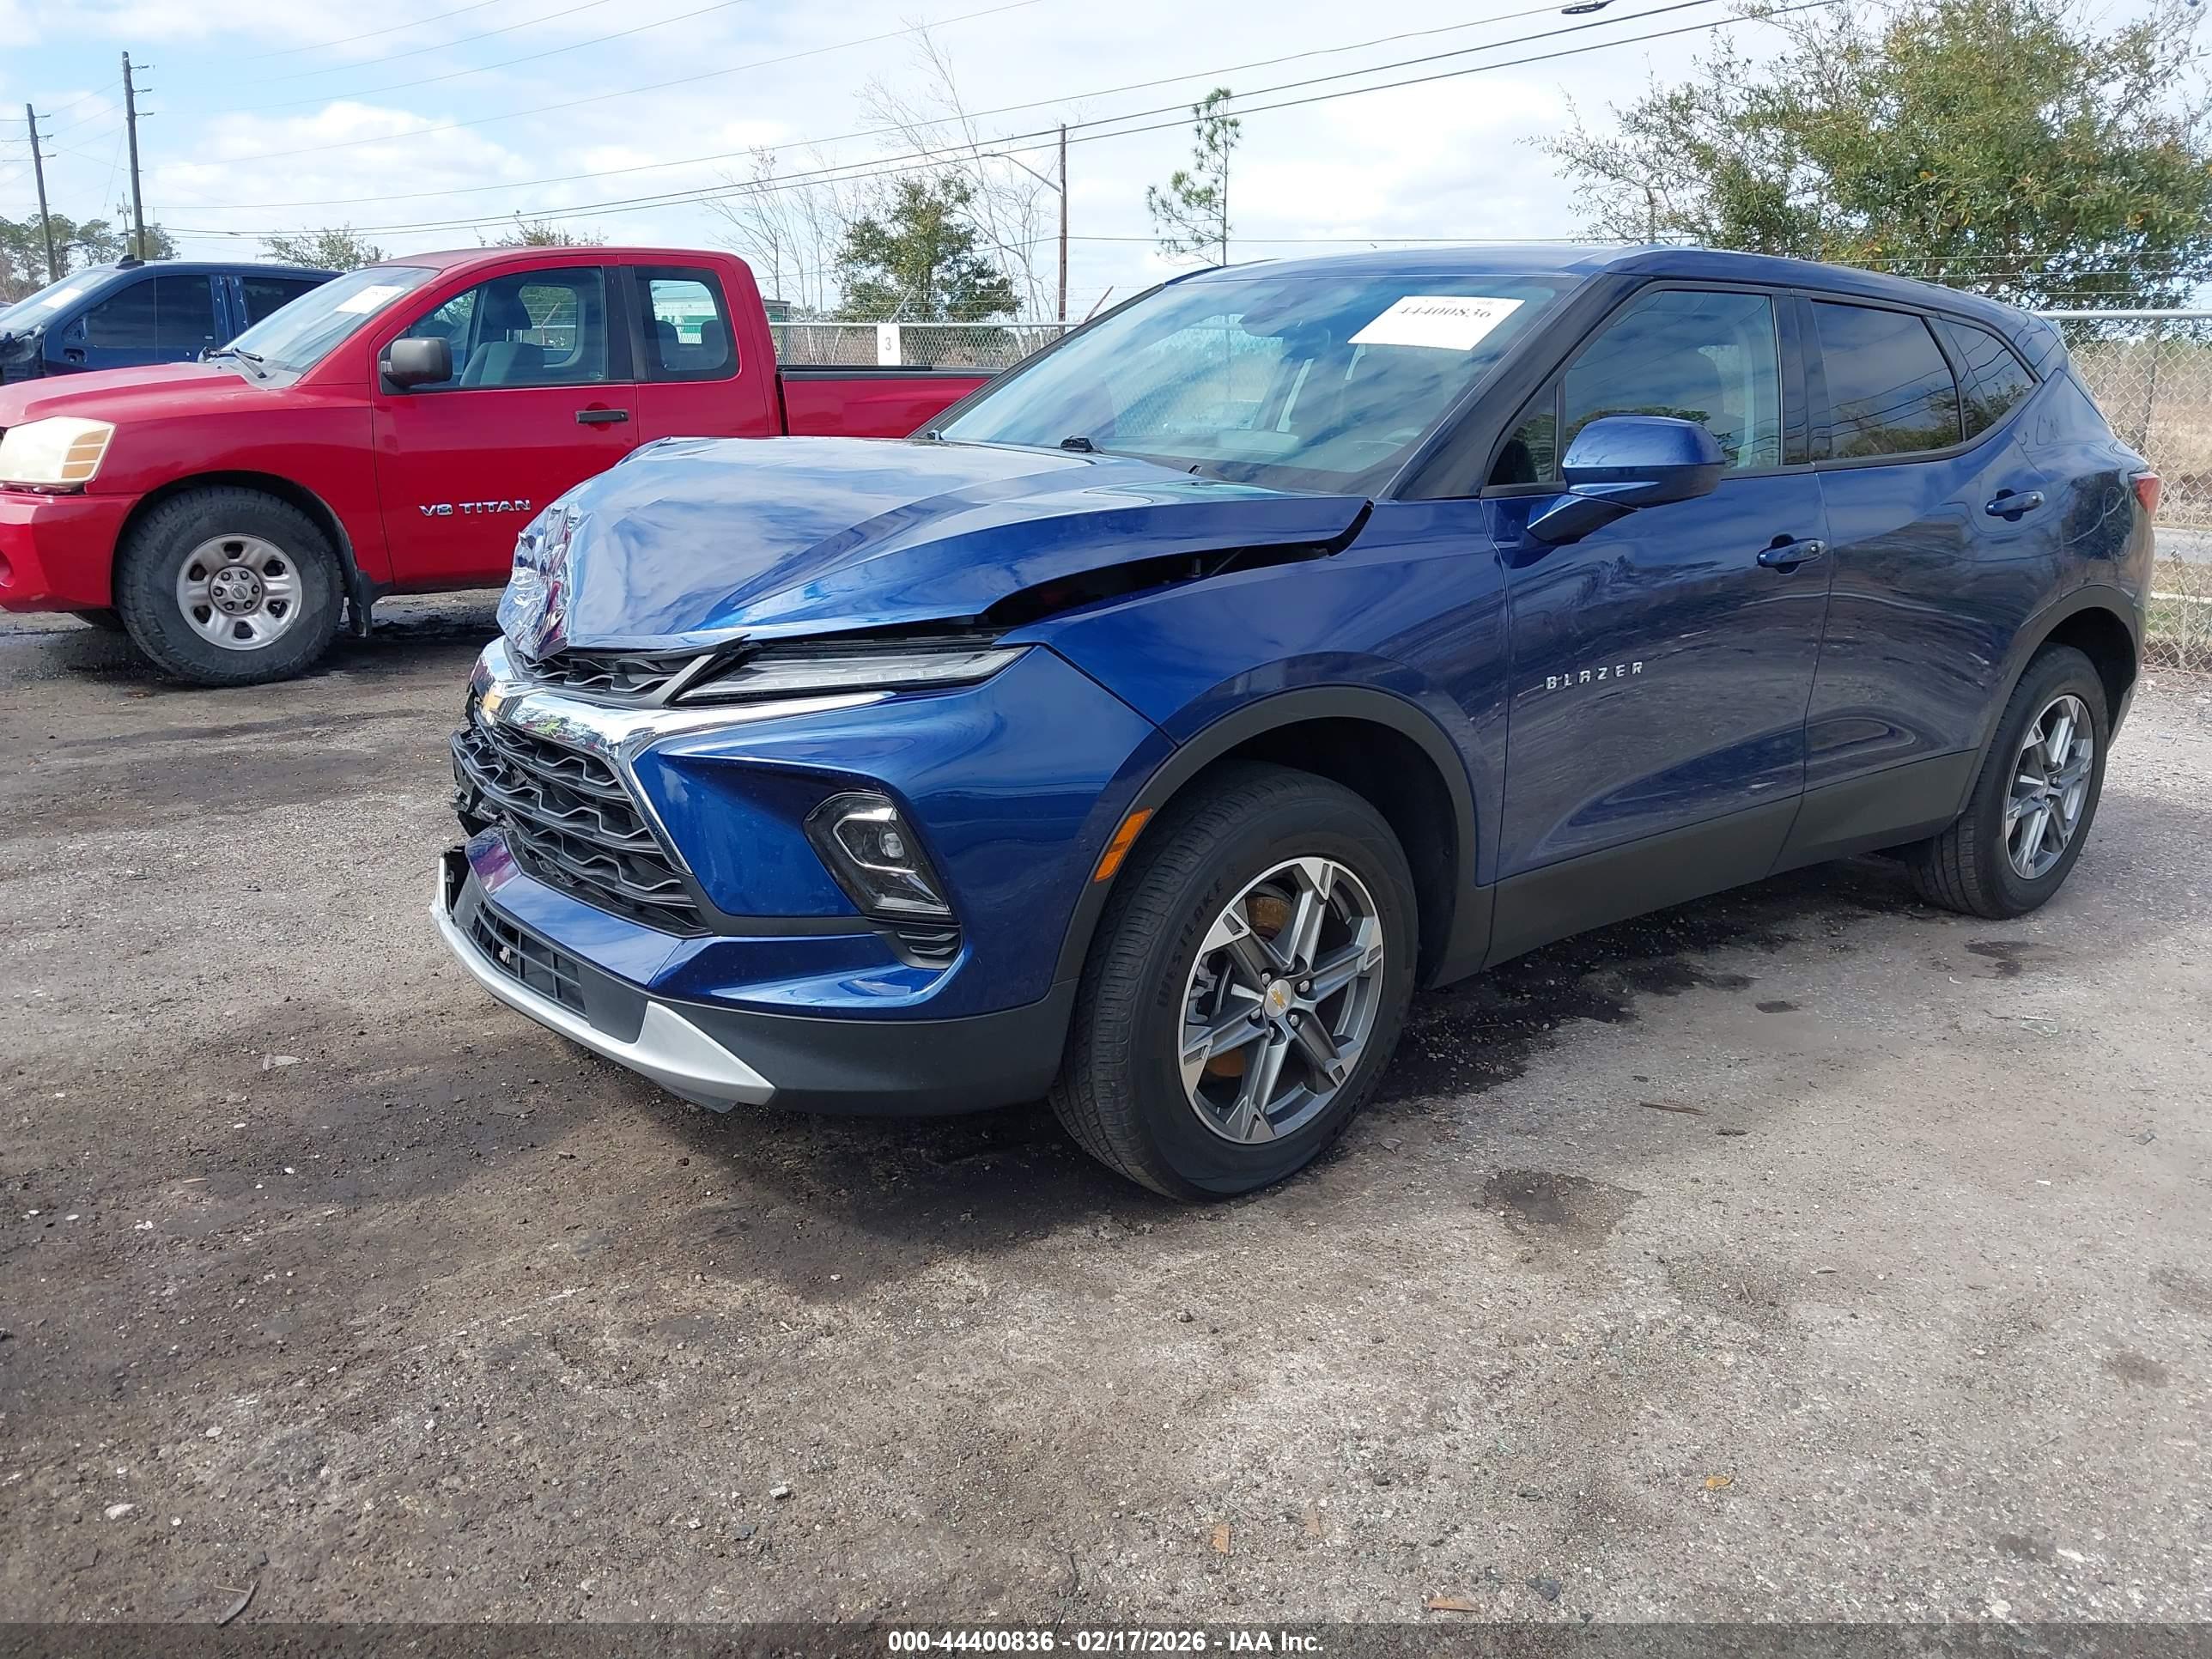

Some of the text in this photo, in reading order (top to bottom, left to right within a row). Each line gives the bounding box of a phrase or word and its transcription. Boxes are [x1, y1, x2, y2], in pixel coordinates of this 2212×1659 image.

[1395, 307, 1492, 318] 44400836
[884, 337, 892, 351] 3
[419, 499, 531, 517] V8 TITAN
[1546, 661, 1643, 690] BLAZER
[1156, 875, 1223, 1008] WESTLAKE
